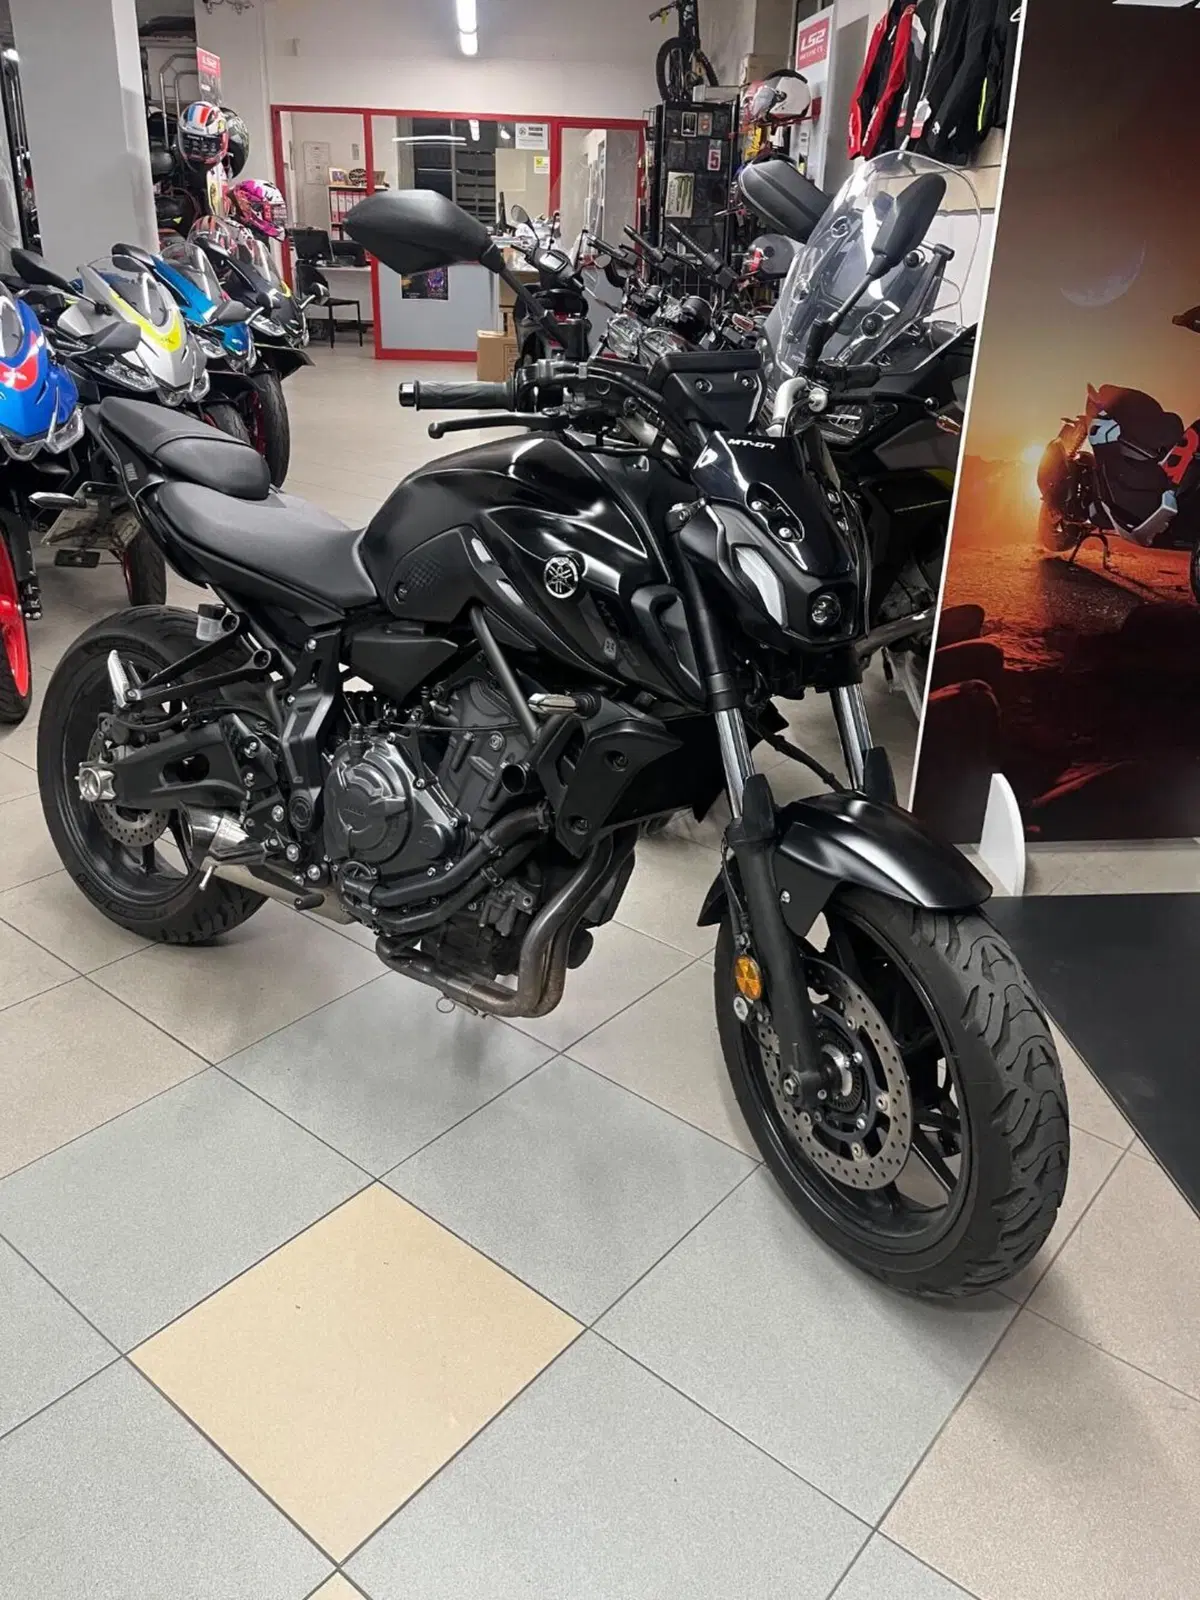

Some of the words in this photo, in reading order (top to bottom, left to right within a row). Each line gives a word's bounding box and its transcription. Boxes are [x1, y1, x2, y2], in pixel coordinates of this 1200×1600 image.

[800, 28, 827, 52] LS2
[710, 151, 720, 169] 5
[727, 438, 776, 449] MT-07
